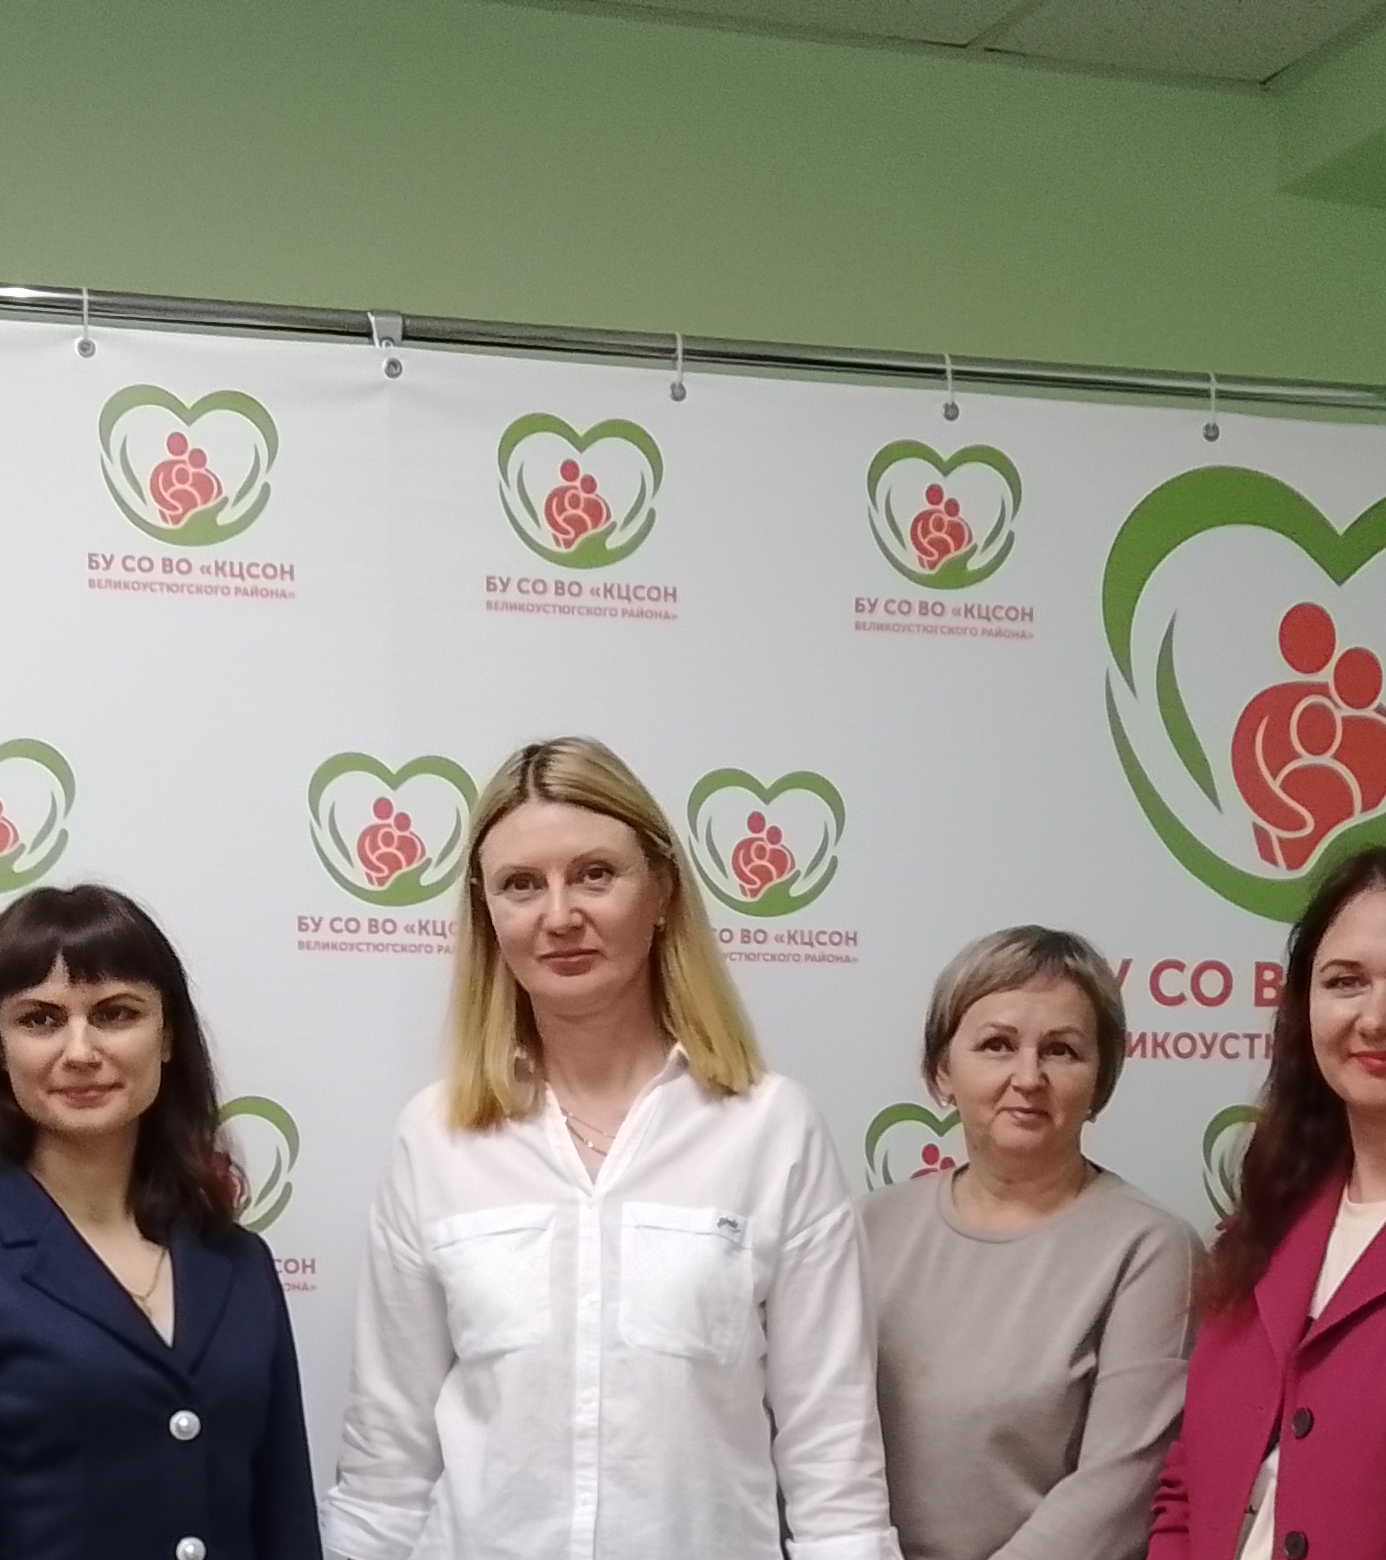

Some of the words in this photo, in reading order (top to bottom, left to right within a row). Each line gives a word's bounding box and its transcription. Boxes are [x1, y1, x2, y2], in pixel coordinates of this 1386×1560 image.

[88, 553, 114, 571] БУ
[121, 555, 154, 573] СО
[162, 557, 192, 575] ВО
[200, 560, 295, 582] «КЦСОН
[486, 576, 511, 592] БУ
[517, 578, 547, 595] СО
[554, 580, 583, 597] ВО
[589, 582, 678, 603] «КЦСОН
[854, 597, 878, 613] БУ
[884, 599, 911, 615] СО
[918, 601, 945, 617] ВО
[952, 603, 1034, 622] «КЦСОН
[297, 915, 323, 933] БУ
[329, 917, 361, 934] СО
[367, 918, 397, 935] ВО
[740, 928, 768, 945] ВО
[1150, 959, 1233, 1007] СО
